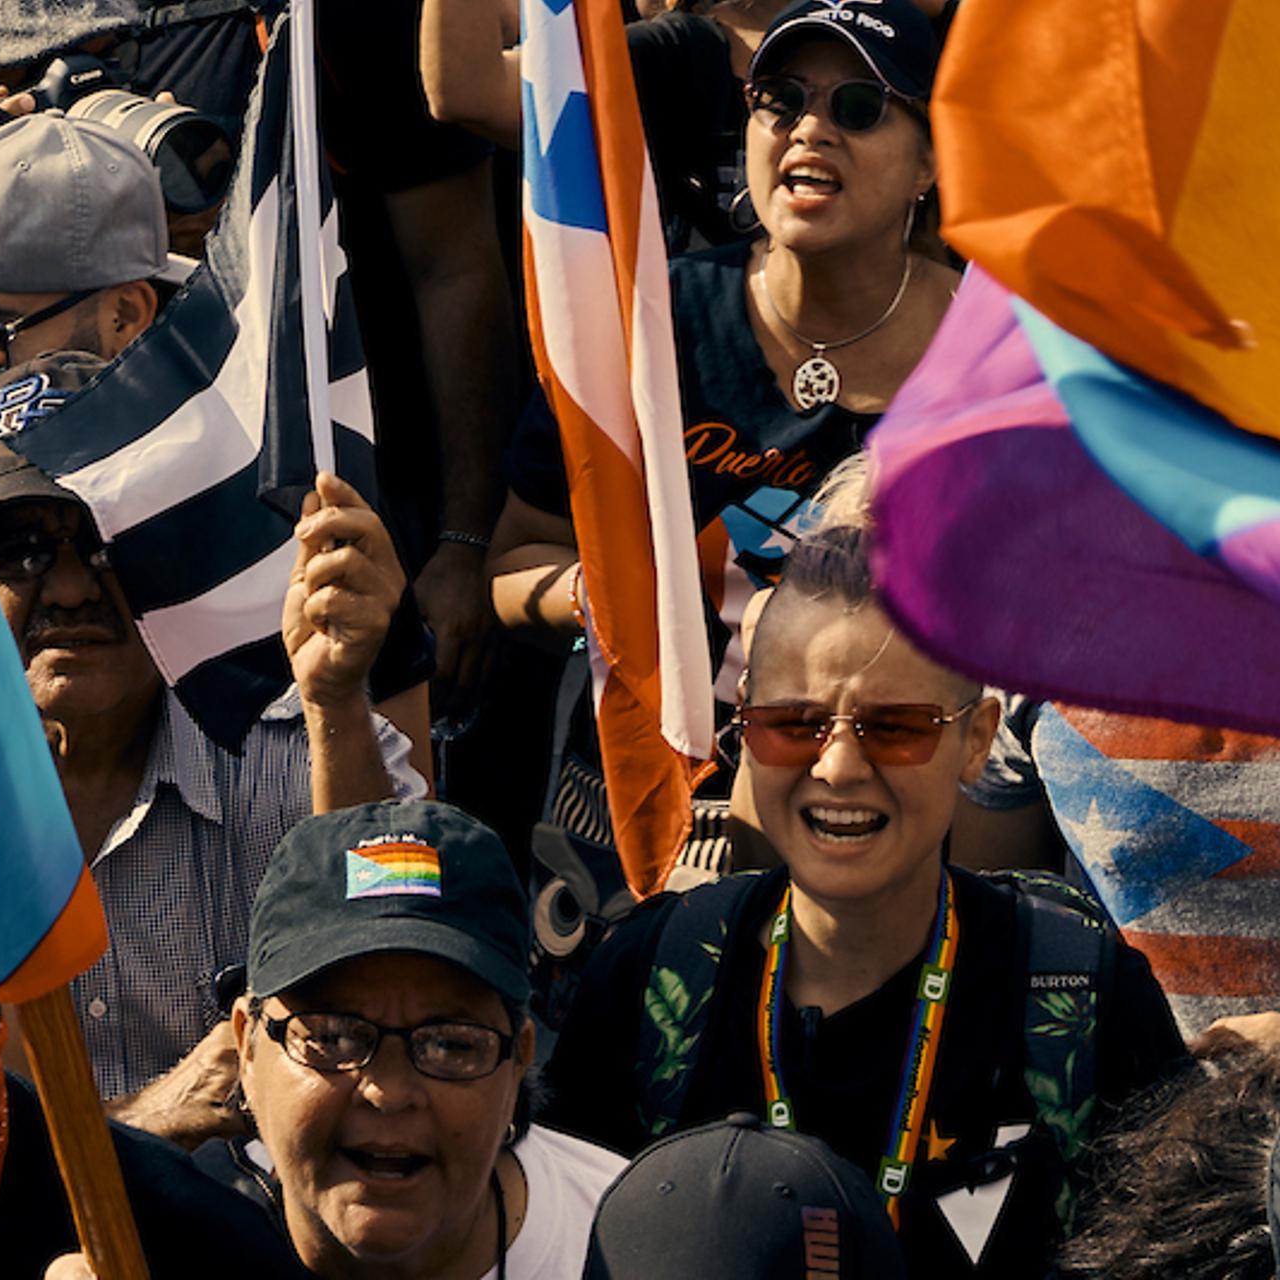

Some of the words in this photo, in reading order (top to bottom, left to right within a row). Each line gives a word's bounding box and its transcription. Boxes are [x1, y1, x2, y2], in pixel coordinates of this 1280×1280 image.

[70, 68, 103, 85] Canon
[682, 422, 816, 487] Puerto
[922, 971, 947, 1001] TD
[1030, 974, 1090, 989] BURTON
[881, 1163, 909, 1194] TD
